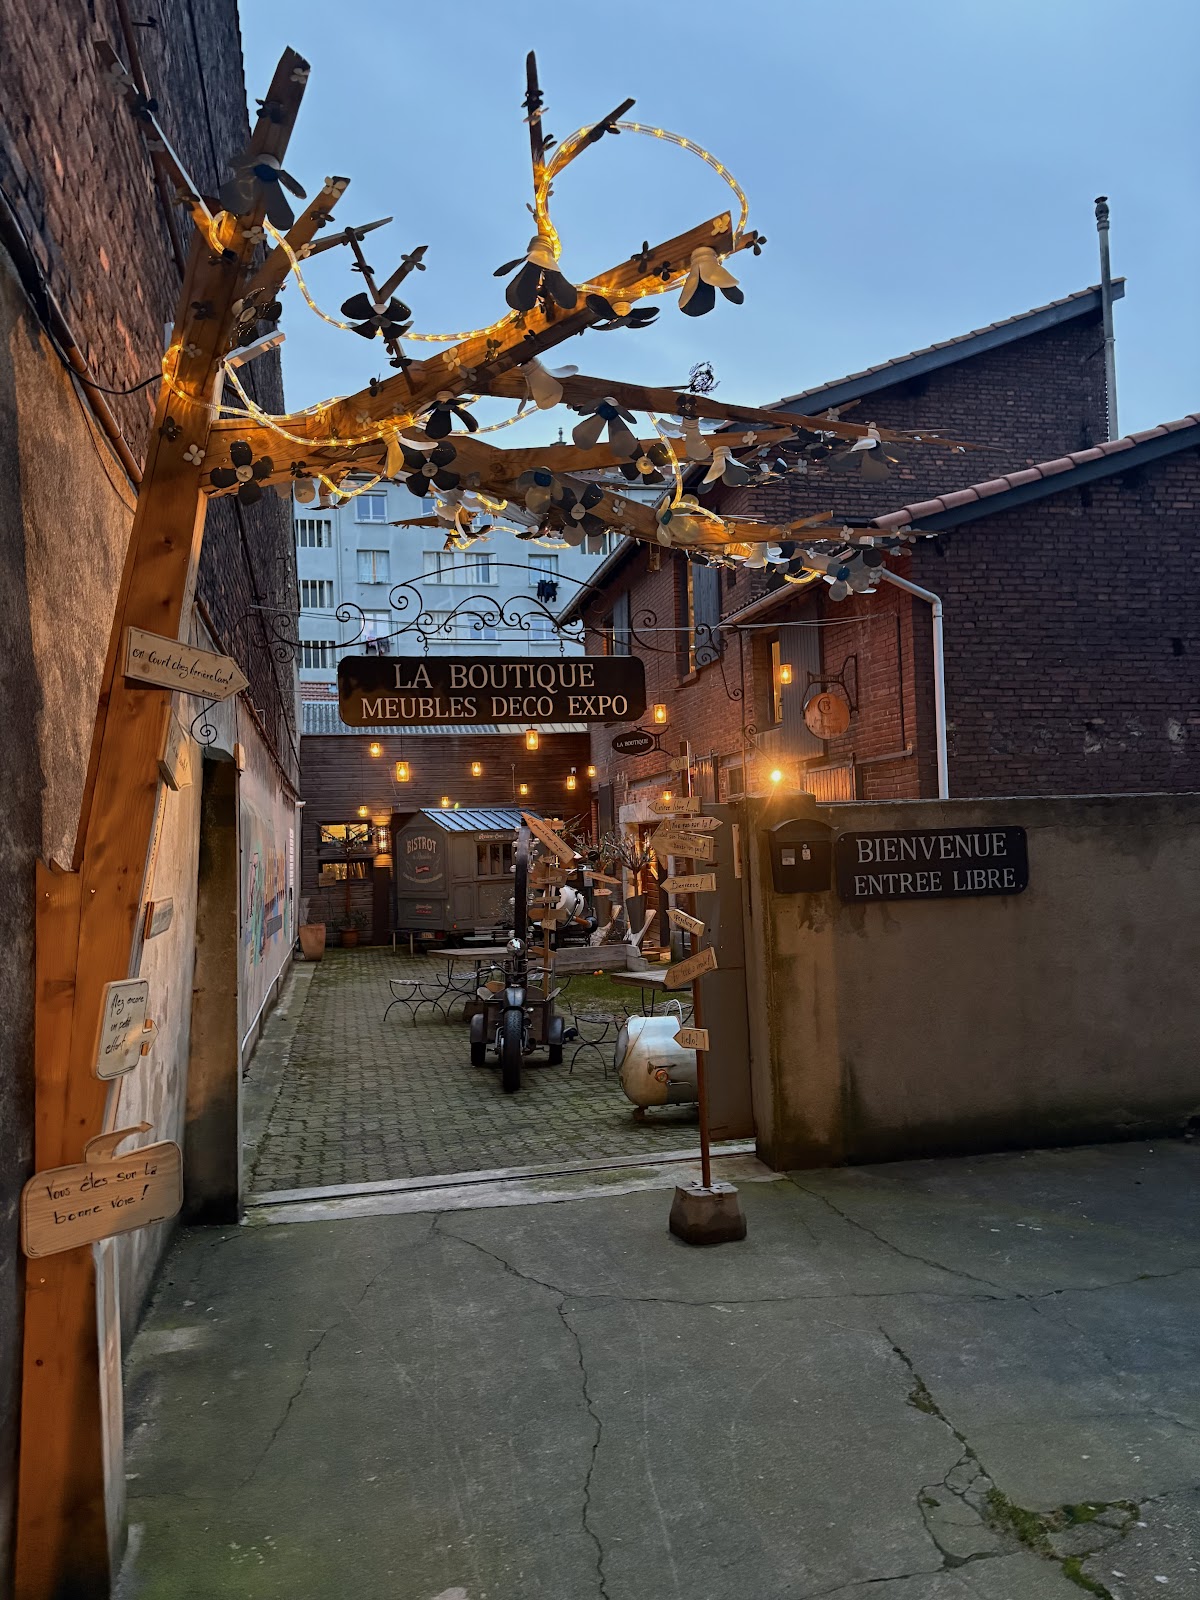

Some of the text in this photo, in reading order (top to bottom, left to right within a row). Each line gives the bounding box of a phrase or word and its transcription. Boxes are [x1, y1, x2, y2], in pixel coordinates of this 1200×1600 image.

[393, 663, 595, 694] LA BOUTIQUE
[361, 695, 628, 719] MEUBLES DECO EXPO
[624, 738, 649, 746] BOUTIQUE
[406, 836, 437, 854] BISTROT
[856, 832, 1007, 864] BIENVENUE
[854, 868, 1016, 896] ENTREE LIBRE
[46, 1179, 71, 1201] Vous
[80, 1172, 108, 1192] êtes
[116, 1171, 137, 1182] sur
[54, 1206, 103, 1225] bonne
